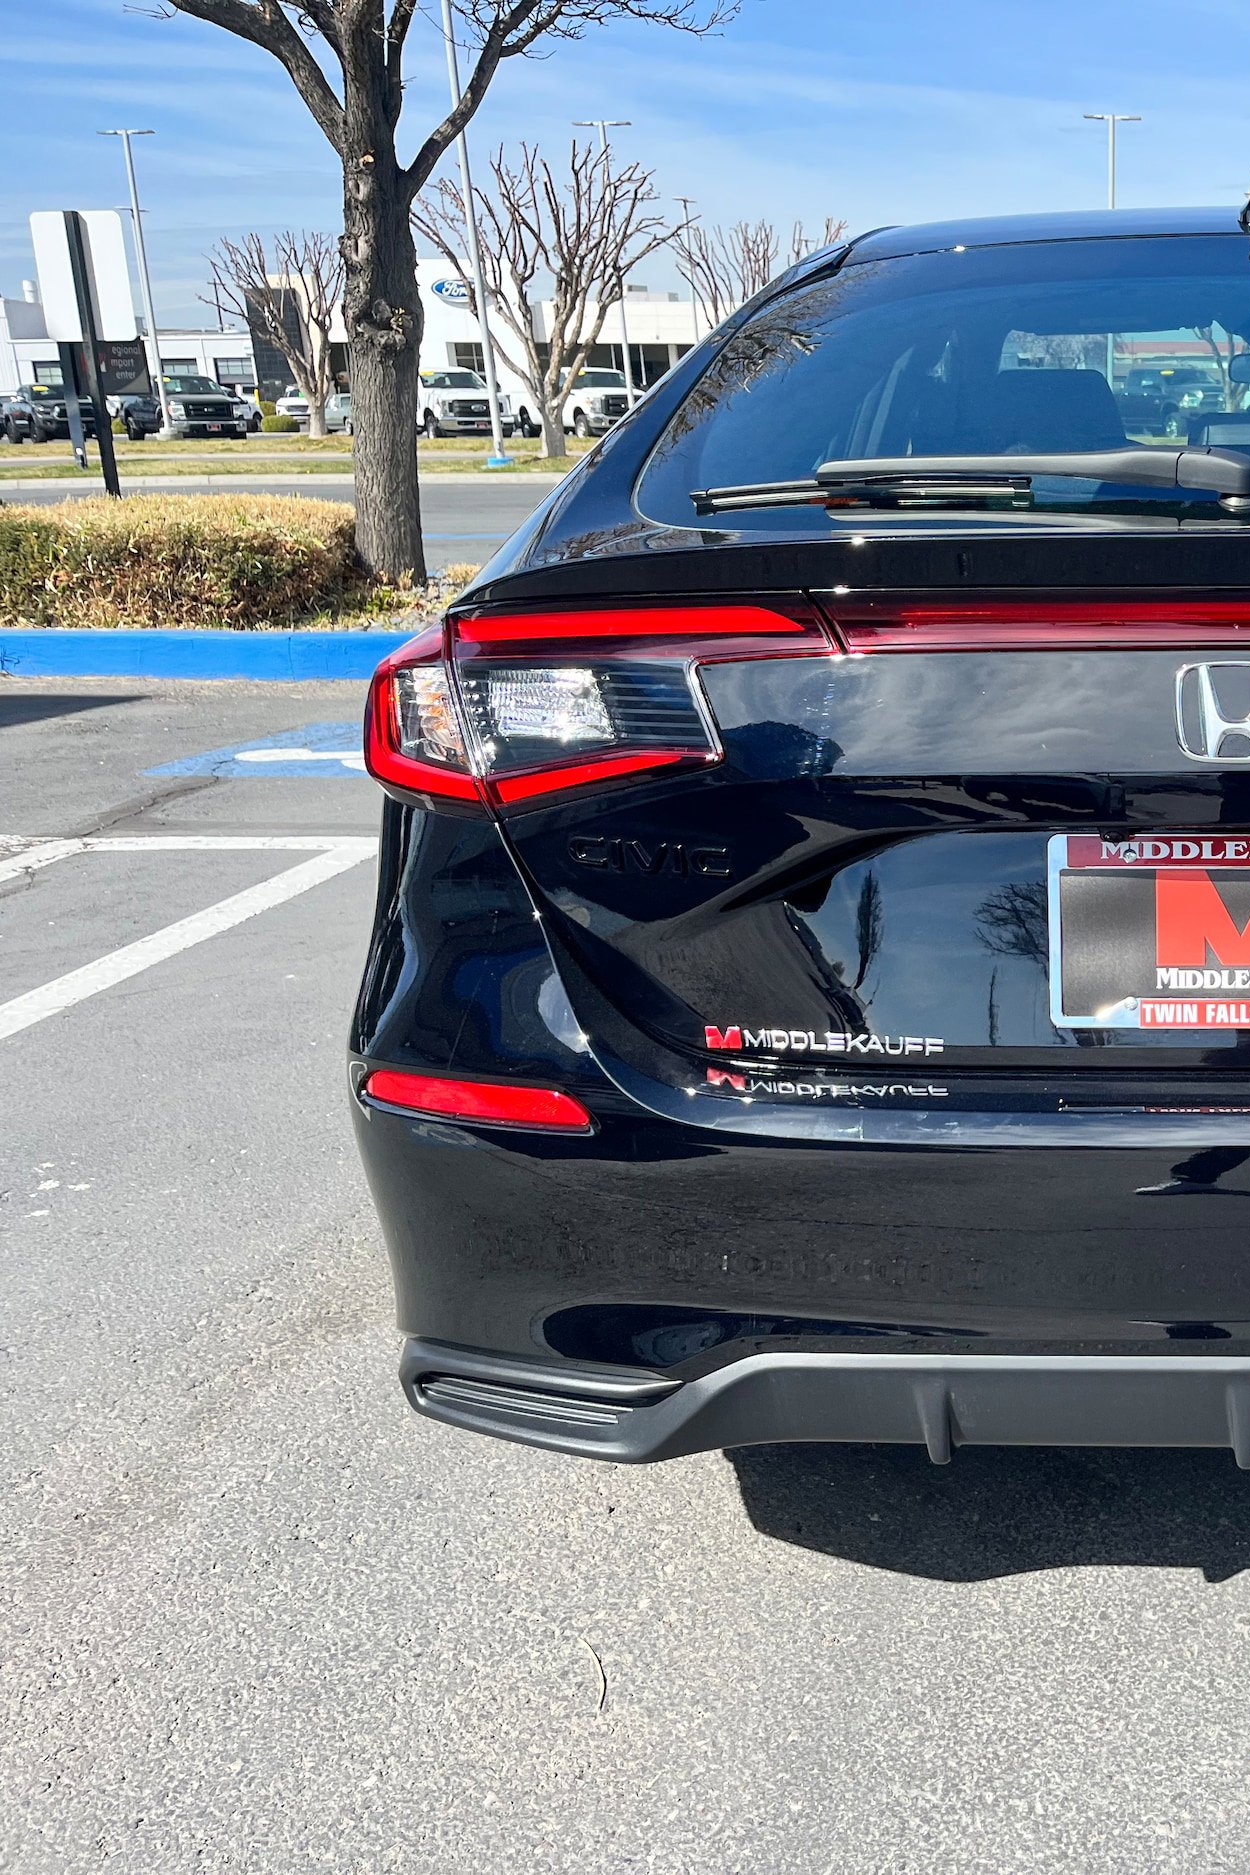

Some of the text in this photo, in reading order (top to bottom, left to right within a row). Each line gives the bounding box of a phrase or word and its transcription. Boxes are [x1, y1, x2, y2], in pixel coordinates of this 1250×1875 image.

[568, 836, 731, 876] CIVIC
[1142, 1002, 1197, 1025] TWIN
[743, 1029, 944, 1056] MIDDLEKAUFF
